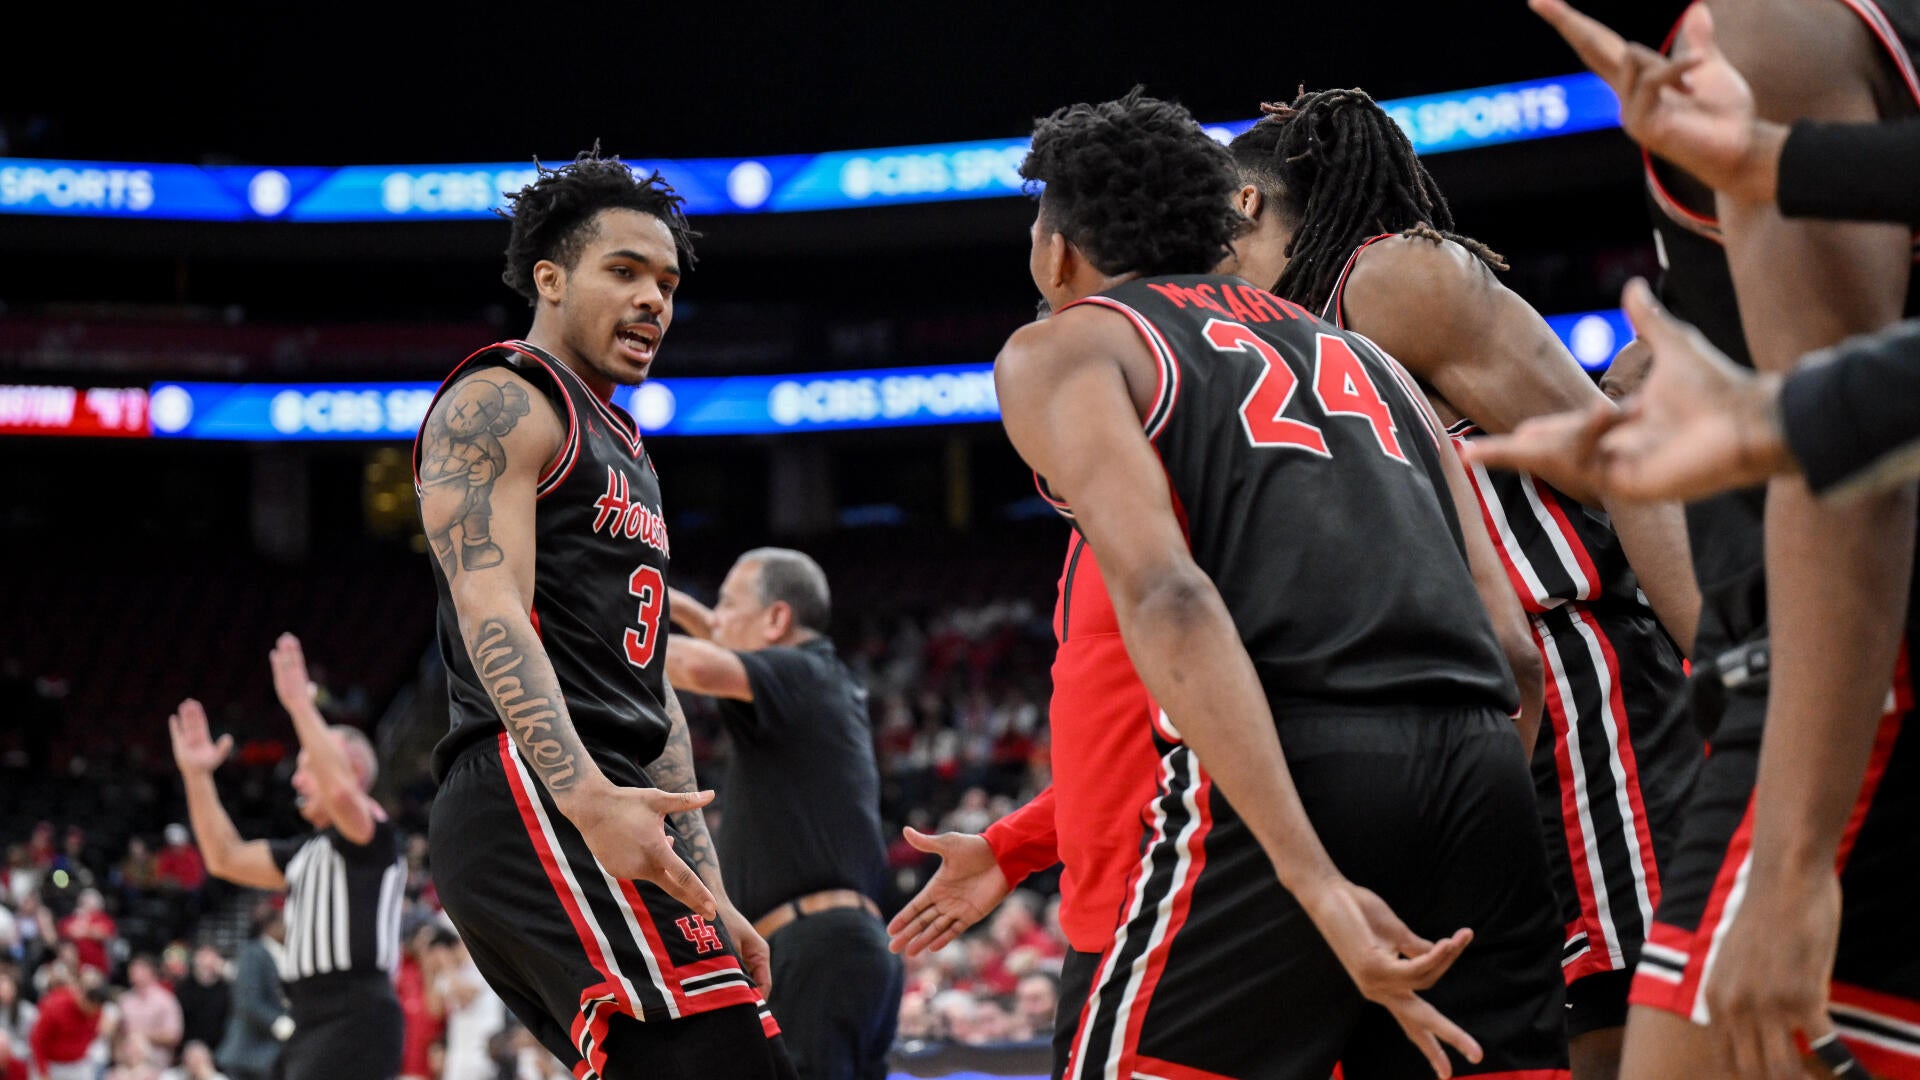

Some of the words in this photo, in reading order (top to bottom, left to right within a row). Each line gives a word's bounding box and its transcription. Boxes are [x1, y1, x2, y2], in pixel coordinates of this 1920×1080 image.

[1417, 85, 1570, 144] SPORTS
[0, 166, 155, 212] SPORTS
[1202, 318, 1410, 466] 24
[623, 564, 664, 668] 3
[475, 622, 574, 790] Walker
